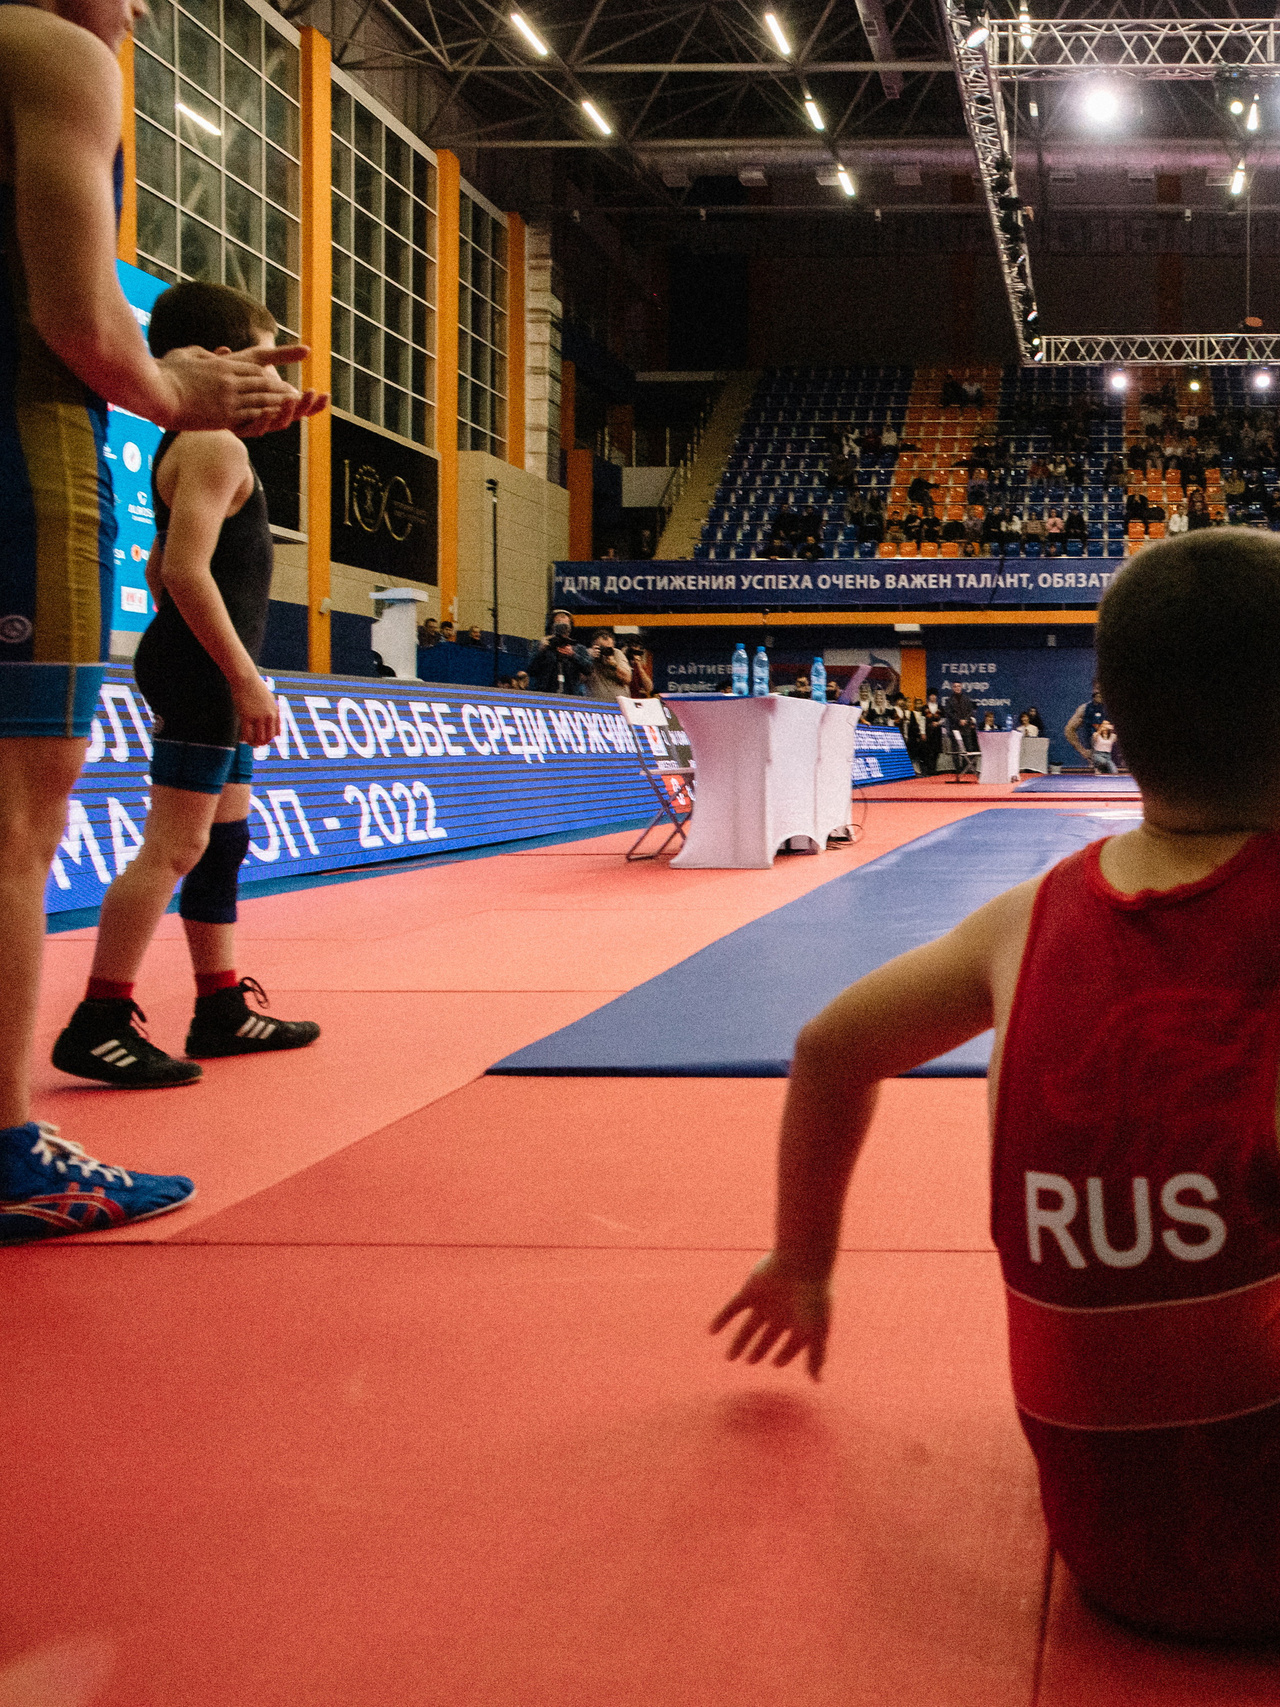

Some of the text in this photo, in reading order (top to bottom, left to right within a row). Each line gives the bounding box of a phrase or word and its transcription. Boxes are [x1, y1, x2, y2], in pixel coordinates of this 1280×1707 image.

[604, 575, 737, 593] ДОСТИЖЕНИЯ
[740, 575, 813, 590] УСПЕХА
[817, 574, 881, 590] ОЧЕНЬ
[884, 574, 951, 589] ВАЖЕН
[955, 573, 1034, 590] ТАЛАНТ,
[1037, 572, 1114, 589] ОБЯЗАТ
[941, 663, 997, 675] ГЕДУЕВ
[667, 680, 717, 694] Бувайс
[941, 680, 990, 693] Ауар
[303, 696, 467, 760] БОРЬБЕ
[461, 703, 555, 764] СРЕДИ
[50, 774, 448, 890] МАОП - 2022
[1024, 1171, 1228, 1270] RUS
